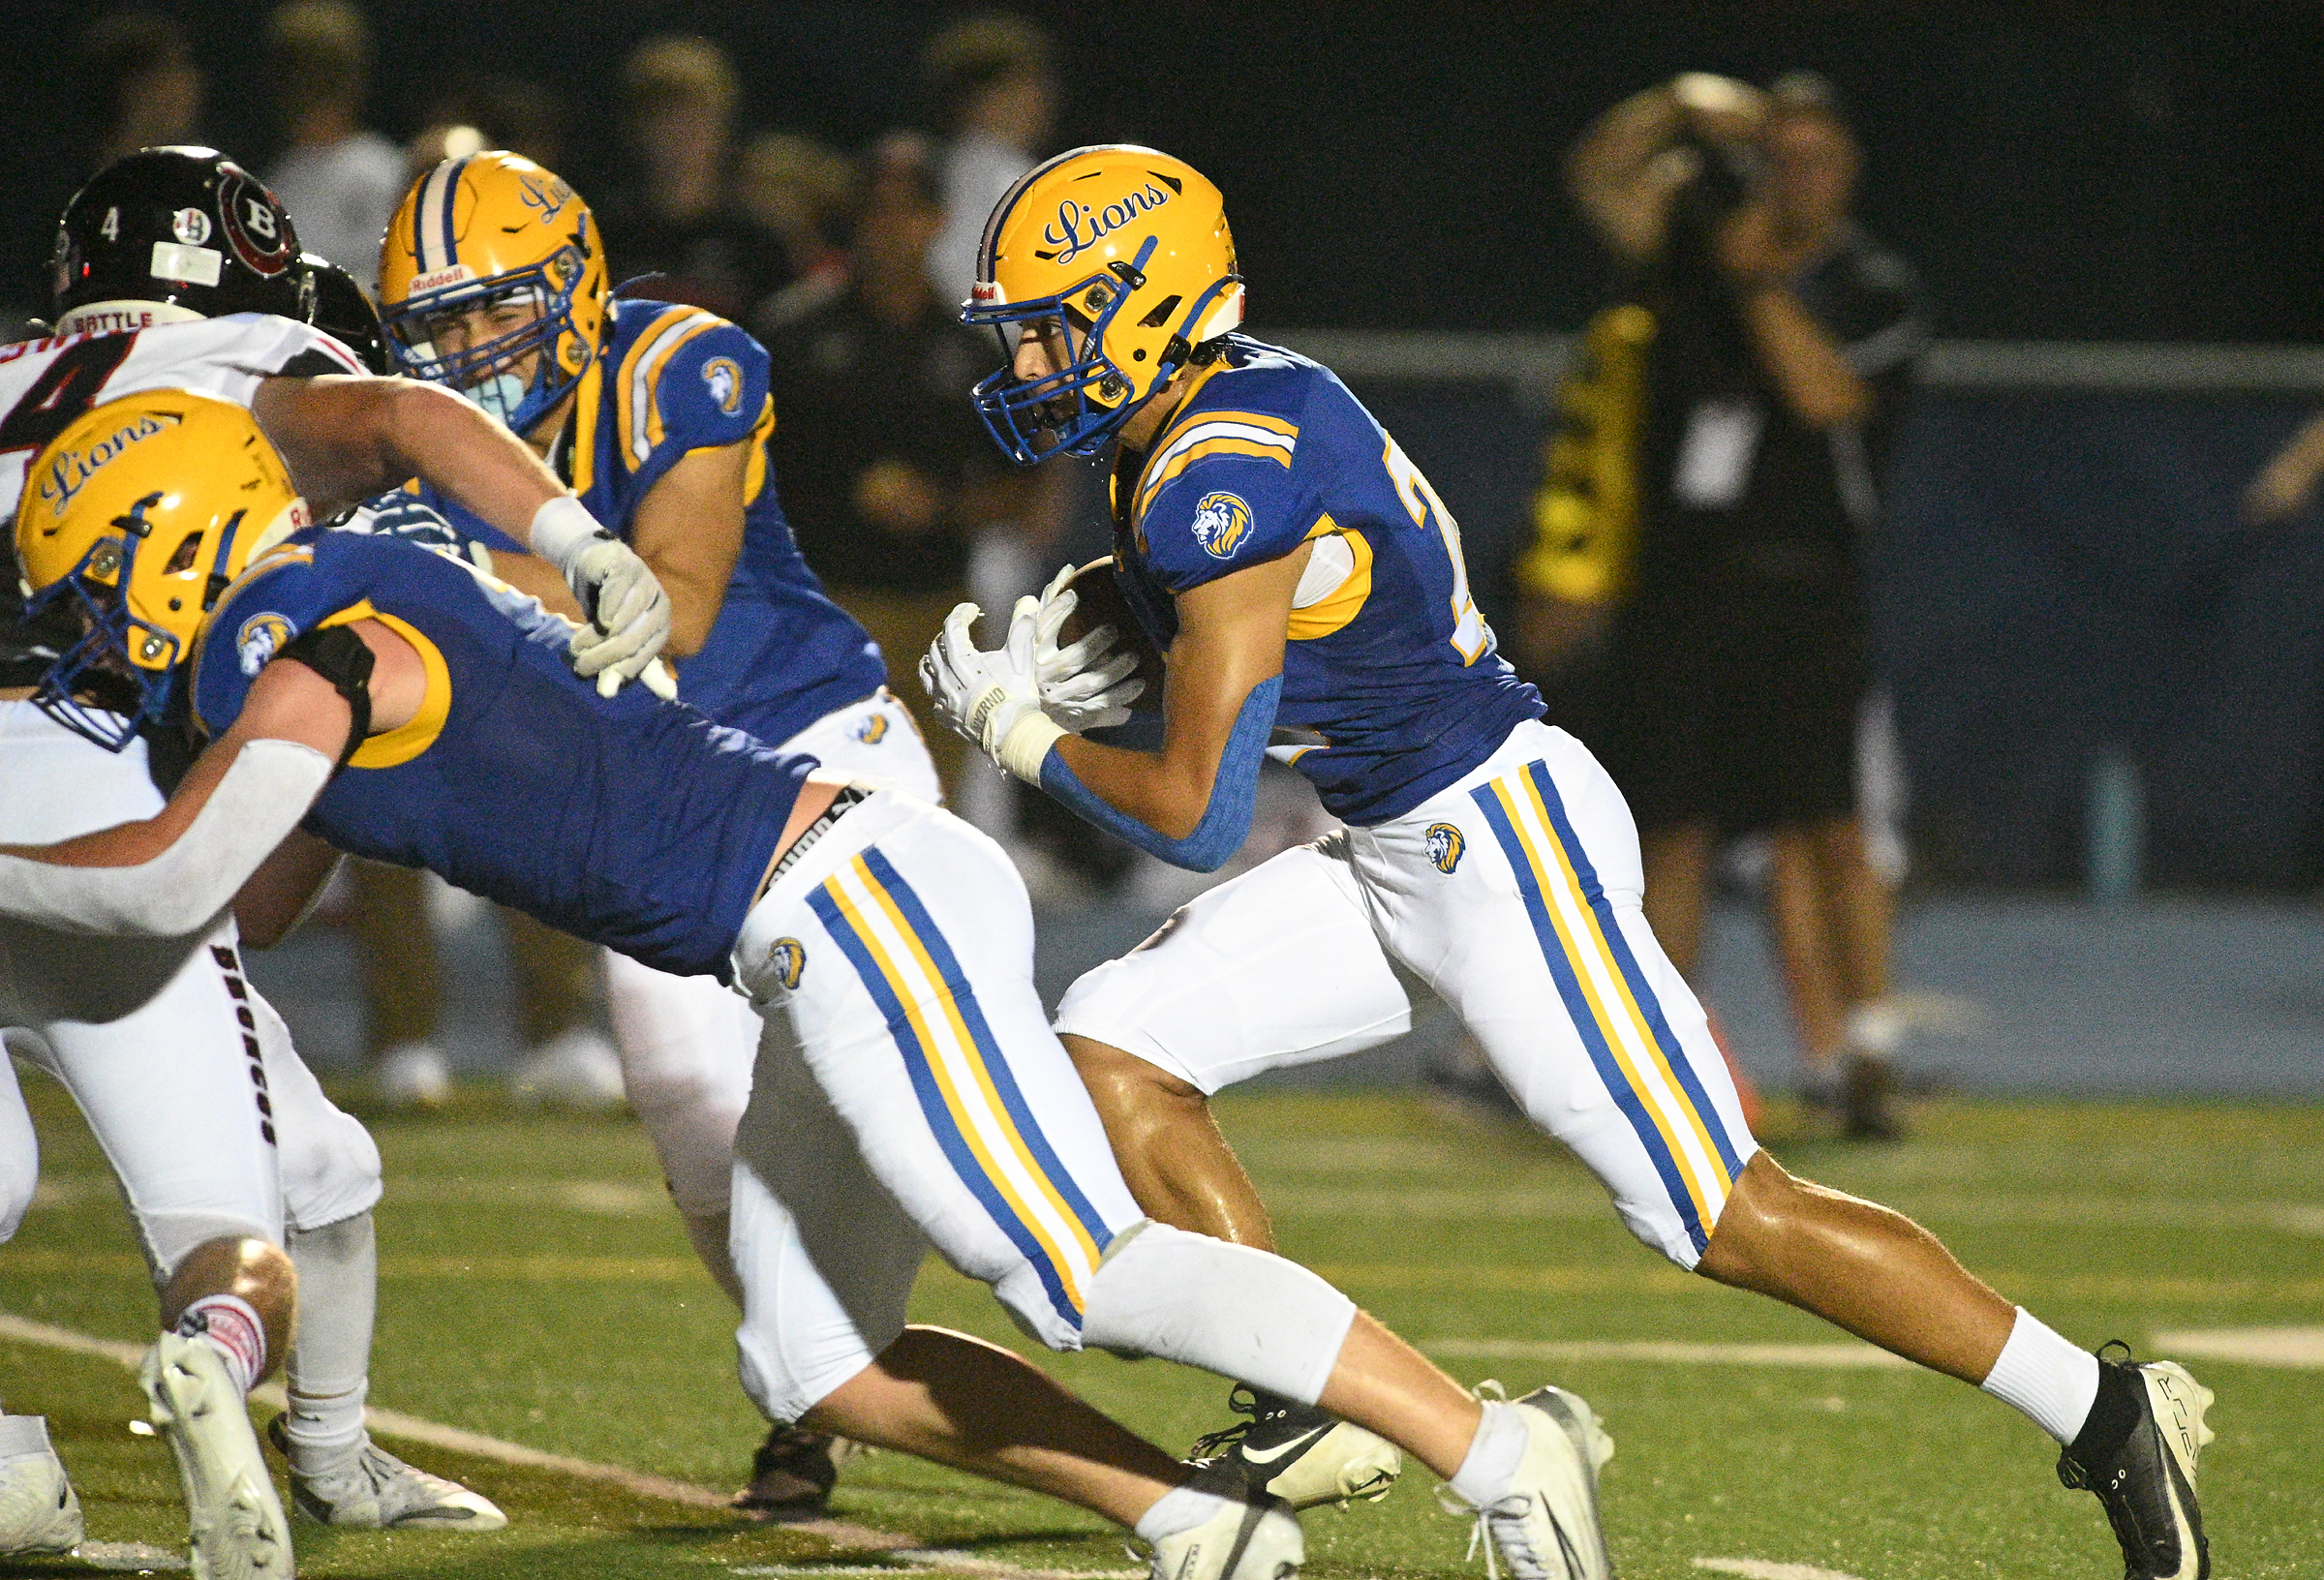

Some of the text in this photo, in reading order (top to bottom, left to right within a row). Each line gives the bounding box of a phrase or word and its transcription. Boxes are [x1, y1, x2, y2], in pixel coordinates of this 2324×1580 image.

[101, 207, 119, 242] 4
[246, 198, 276, 238] B
[1045, 183, 1168, 264] Lions
[74, 312, 152, 333] BATTLE
[40, 414, 165, 517] Lions
